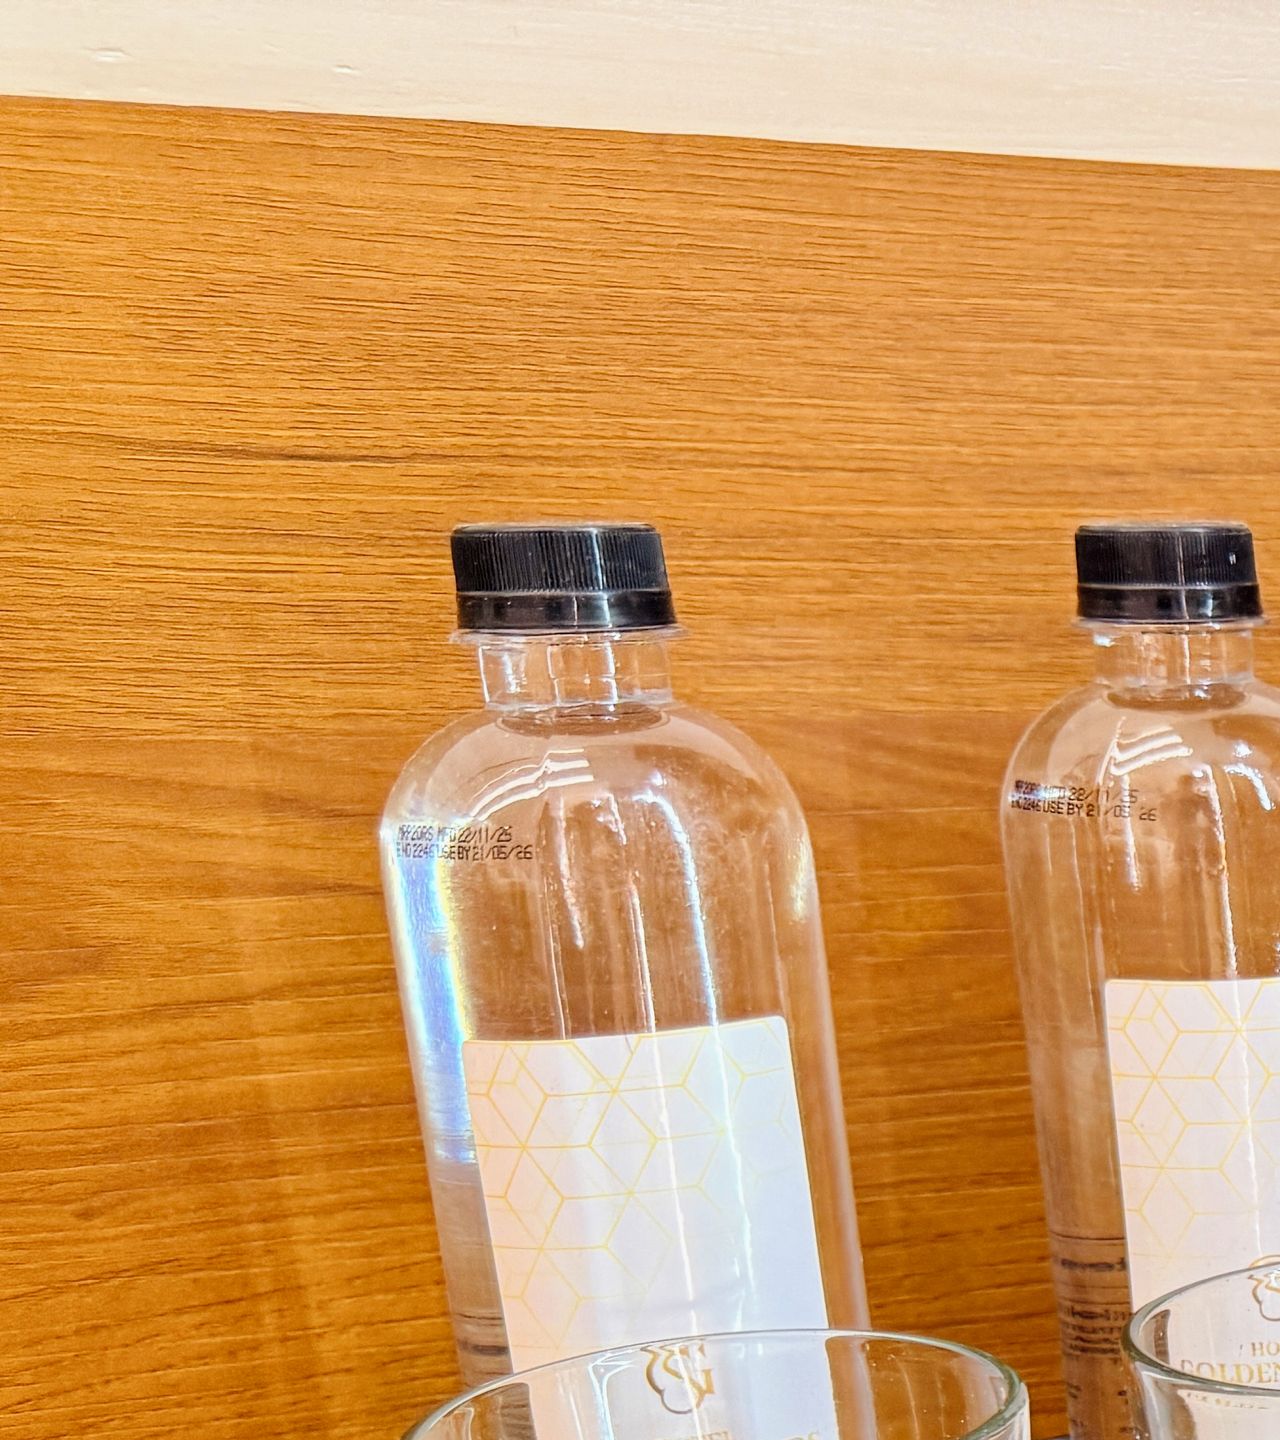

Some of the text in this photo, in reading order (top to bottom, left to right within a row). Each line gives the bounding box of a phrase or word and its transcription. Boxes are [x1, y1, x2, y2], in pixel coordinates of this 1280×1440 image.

[1043, 801, 1064, 815] USE
[1067, 803, 1084, 817] BY
[1085, 803, 1158, 822] 21/0526
[457, 845, 472, 861] BY
[473, 844, 533, 861] 21/05/26
